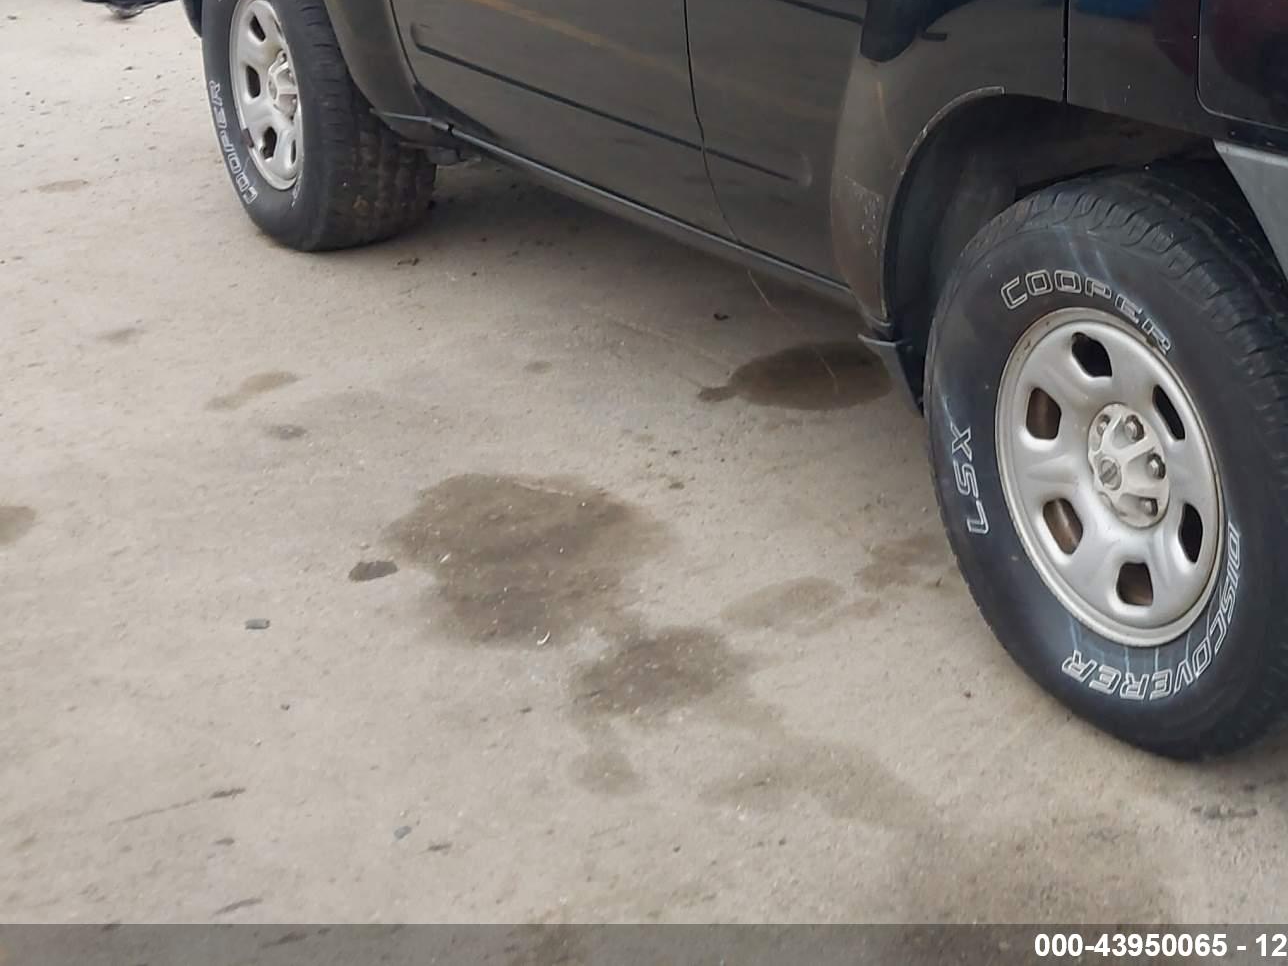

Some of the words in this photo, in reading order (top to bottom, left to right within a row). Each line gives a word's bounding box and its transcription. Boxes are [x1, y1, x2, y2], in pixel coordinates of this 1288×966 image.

[209, 80, 258, 204] COOPER
[1001, 269, 1171, 355] COOPER
[950, 420, 989, 534] LSX
[1062, 521, 1241, 701] DISCOVERER
